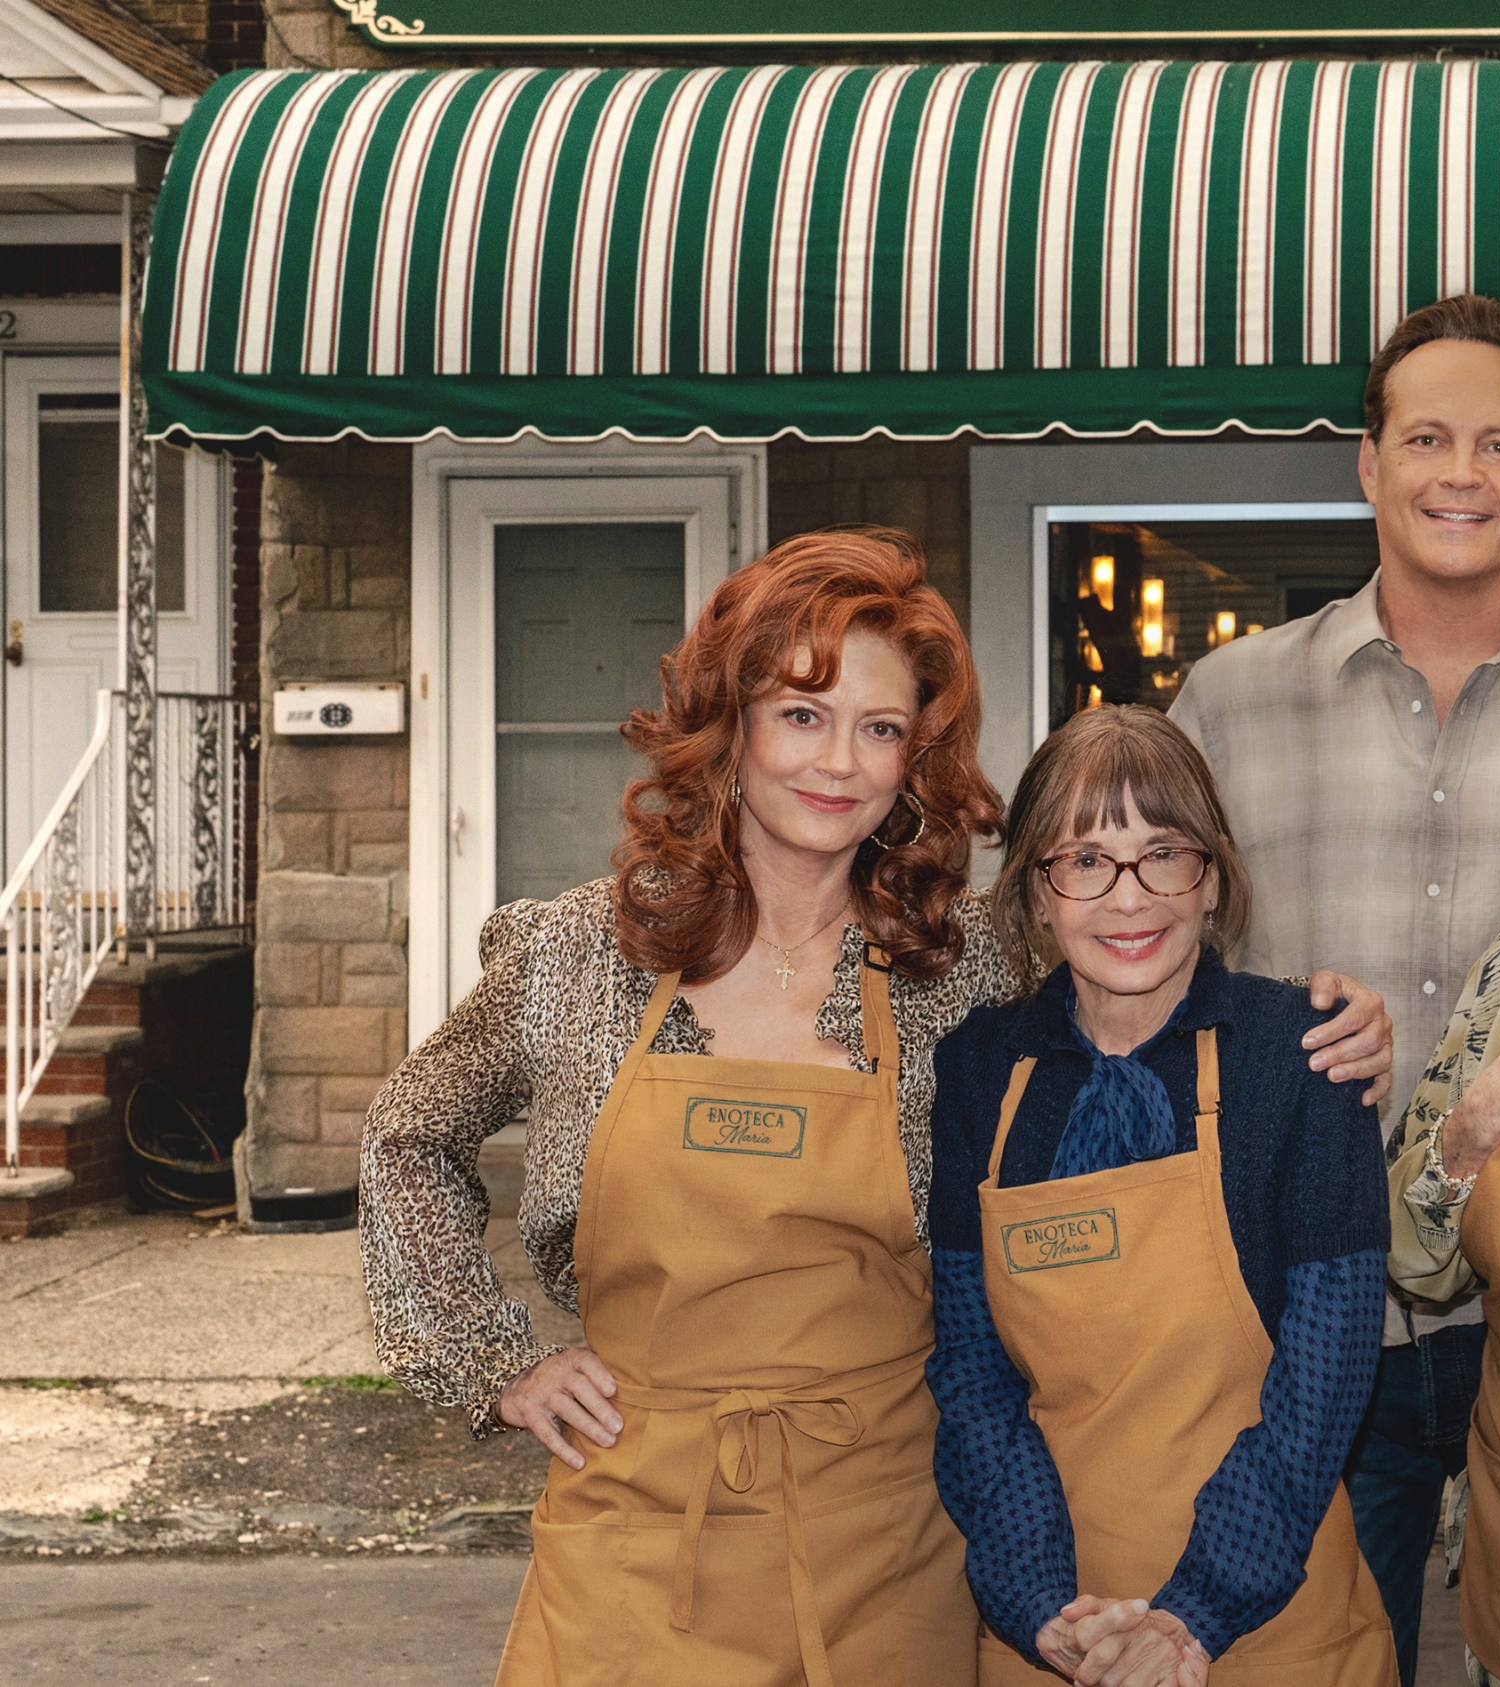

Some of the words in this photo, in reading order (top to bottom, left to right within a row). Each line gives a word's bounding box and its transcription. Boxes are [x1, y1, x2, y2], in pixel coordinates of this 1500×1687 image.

[706, 1107, 785, 1128] ENOTECA
[714, 1124, 772, 1145] Maria
[1023, 1219, 1099, 1245] ENOTECA
[1037, 1238, 1091, 1264] Maria
